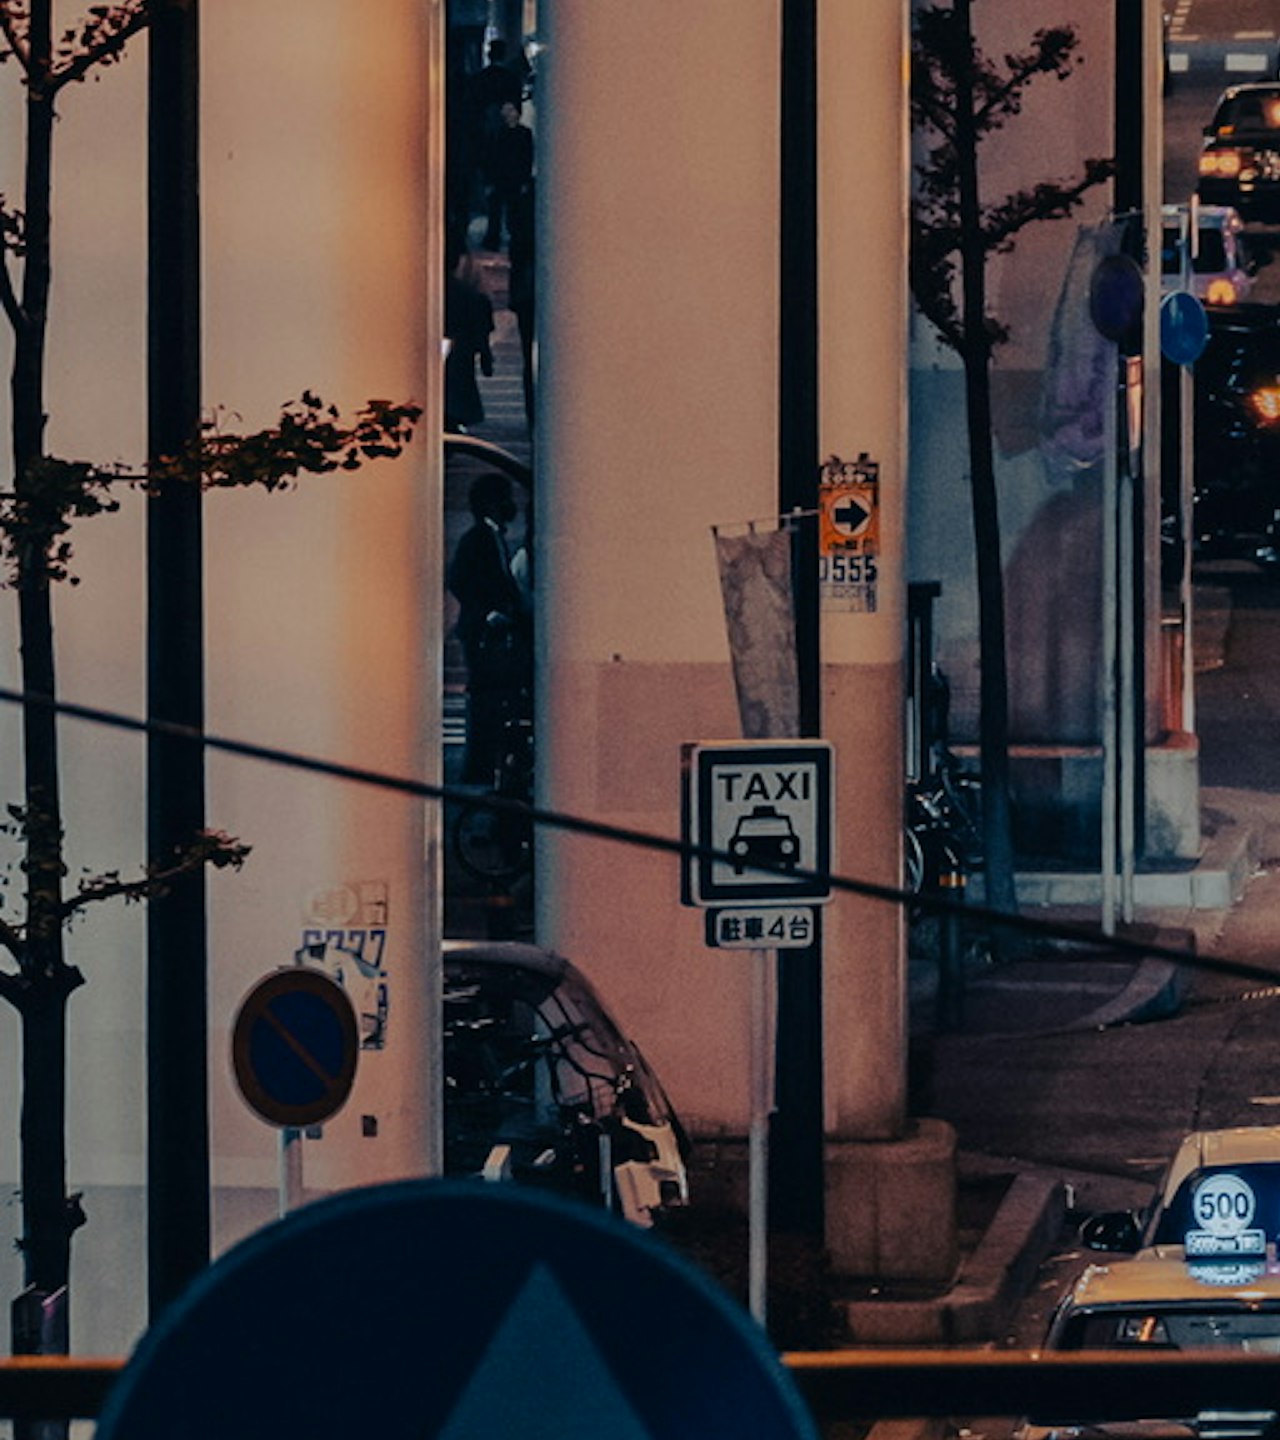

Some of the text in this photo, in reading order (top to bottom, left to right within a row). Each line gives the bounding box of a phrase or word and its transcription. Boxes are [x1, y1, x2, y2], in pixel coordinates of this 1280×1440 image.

[717, 772, 810, 800] TAXI
[720, 916, 810, 941] 駐車4台
[1200, 1192, 1249, 1220] 500
